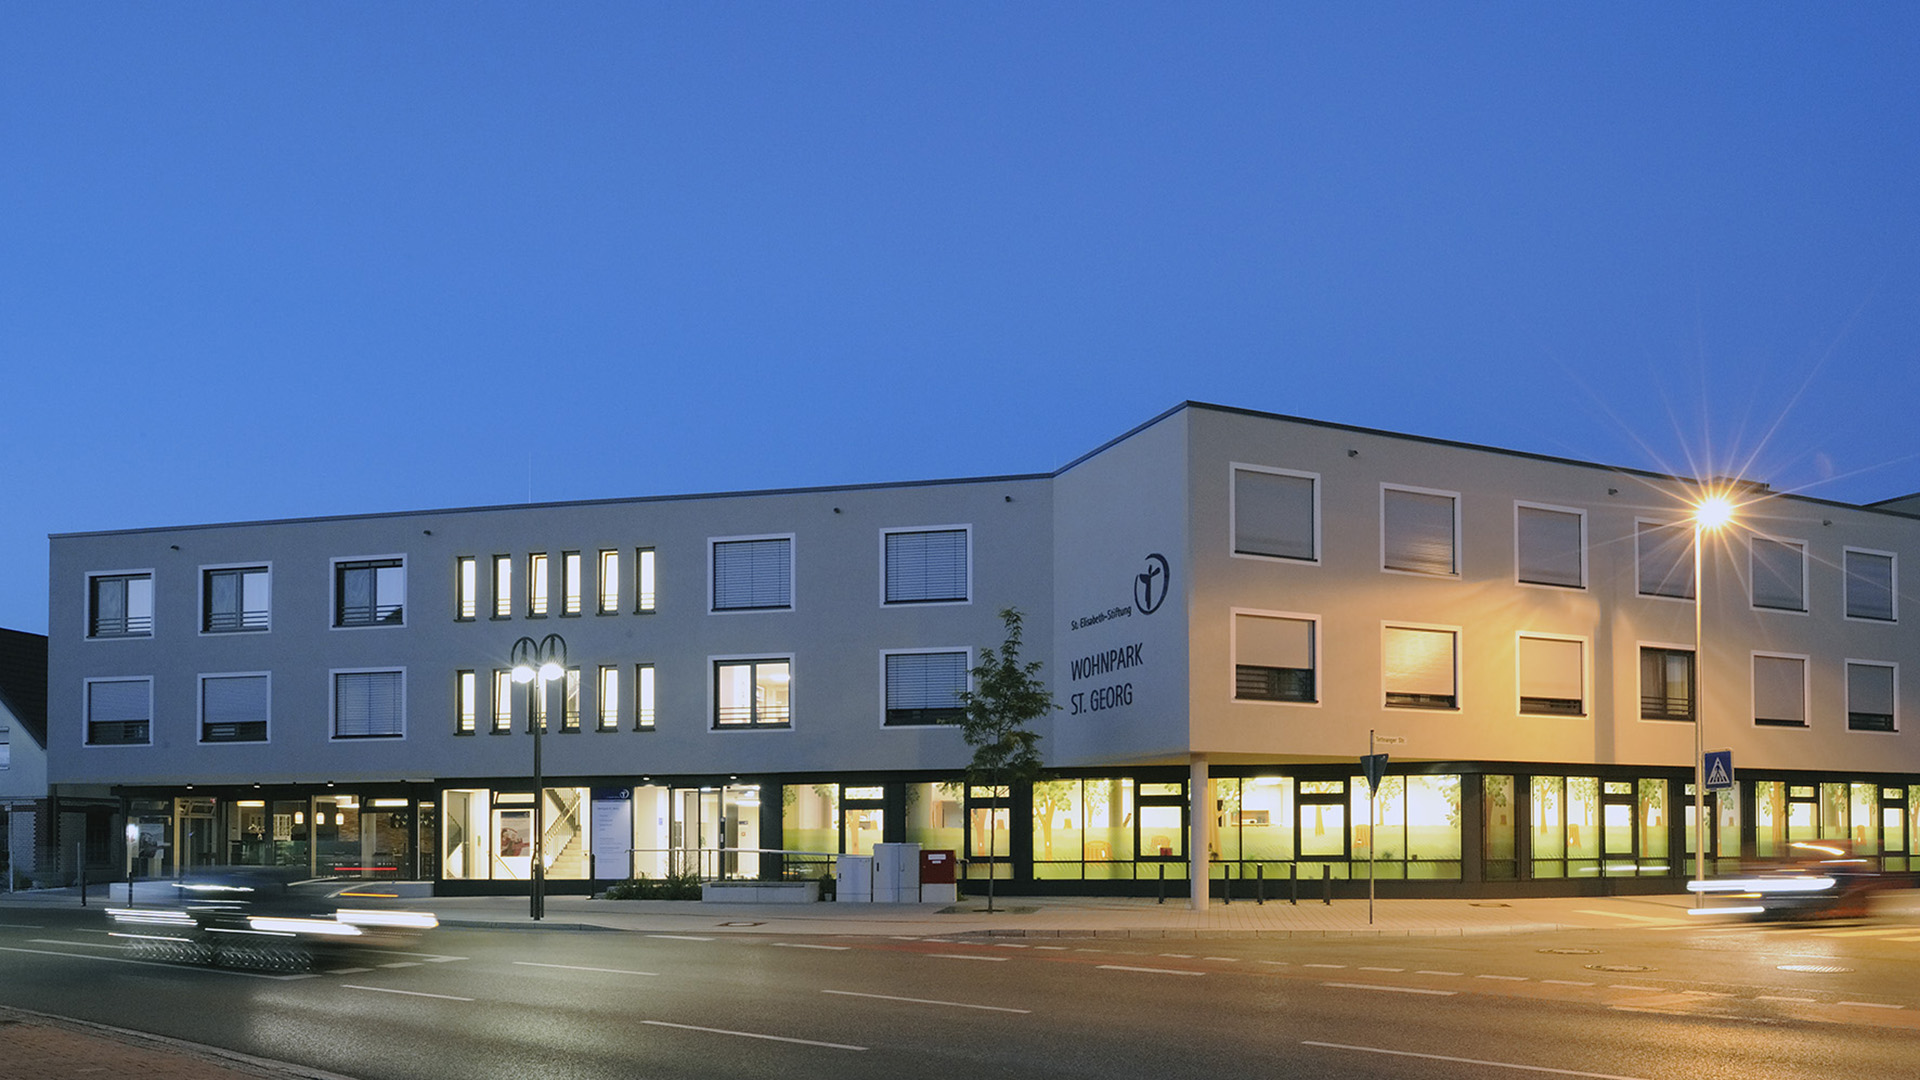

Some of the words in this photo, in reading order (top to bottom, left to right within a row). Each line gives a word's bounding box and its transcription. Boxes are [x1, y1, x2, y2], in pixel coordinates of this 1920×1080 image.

[1071, 620, 1079, 631] St.
[1080, 606, 1132, 628] Elisabeth-Stiftung
[1071, 642, 1143, 681] WOHNPARK
[1071, 693, 1087, 715] ST.
[1090, 683, 1133, 712] GEORG
